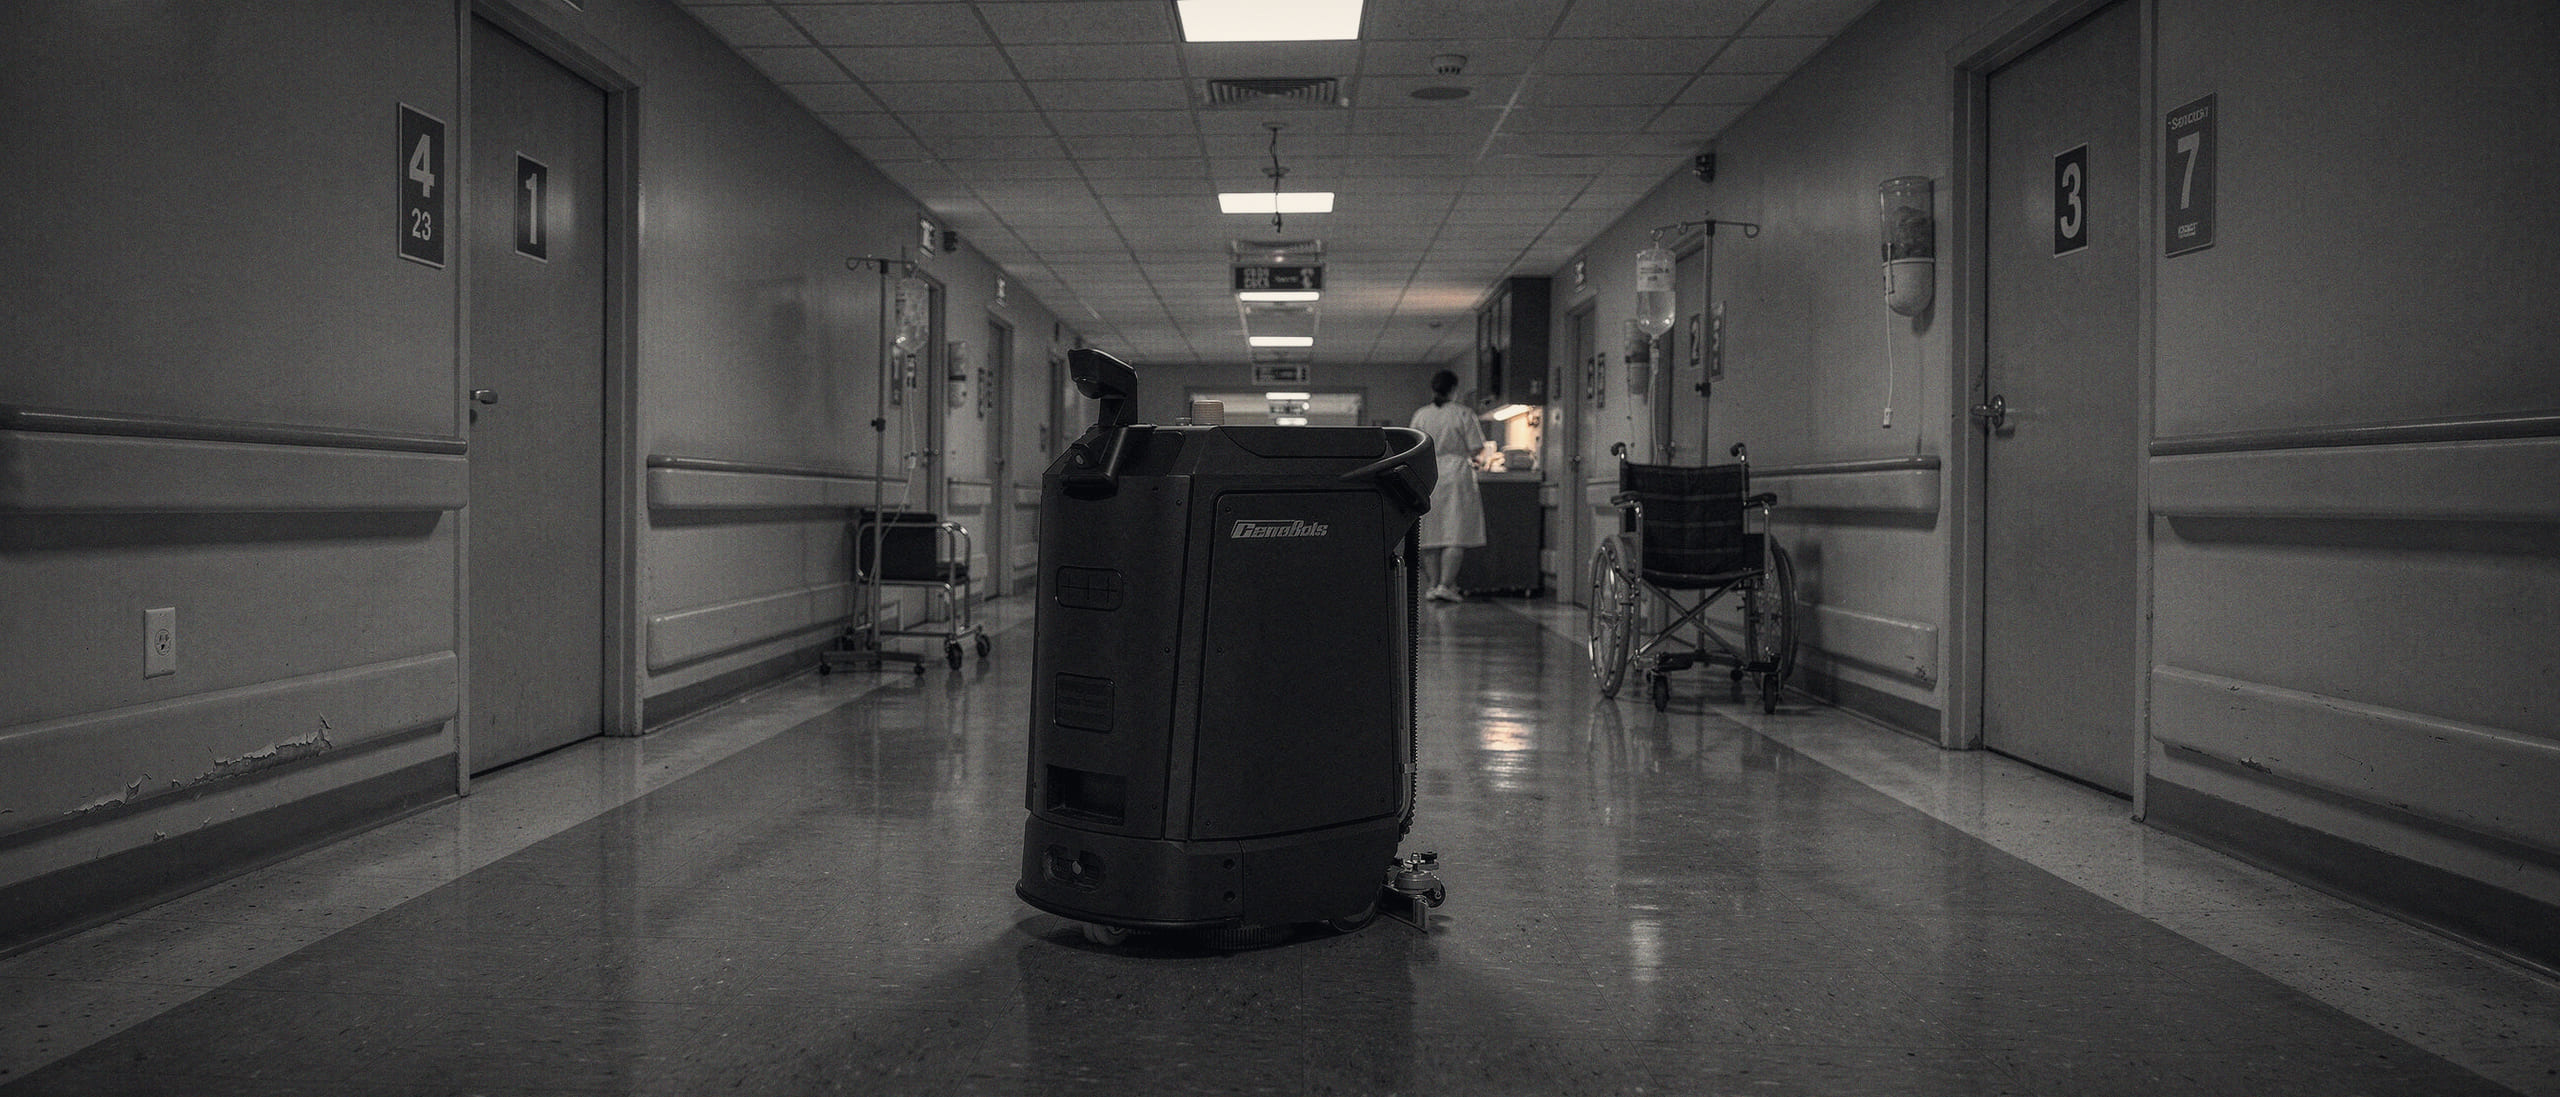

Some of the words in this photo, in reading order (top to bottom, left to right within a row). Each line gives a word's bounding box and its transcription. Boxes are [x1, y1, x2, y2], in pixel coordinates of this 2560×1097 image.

[409, 133, 435, 198] 4
[2060, 162, 2082, 239] 3
[2177, 131, 2200, 210] 7
[411, 207, 432, 241] 23
[525, 172, 538, 245] 1
